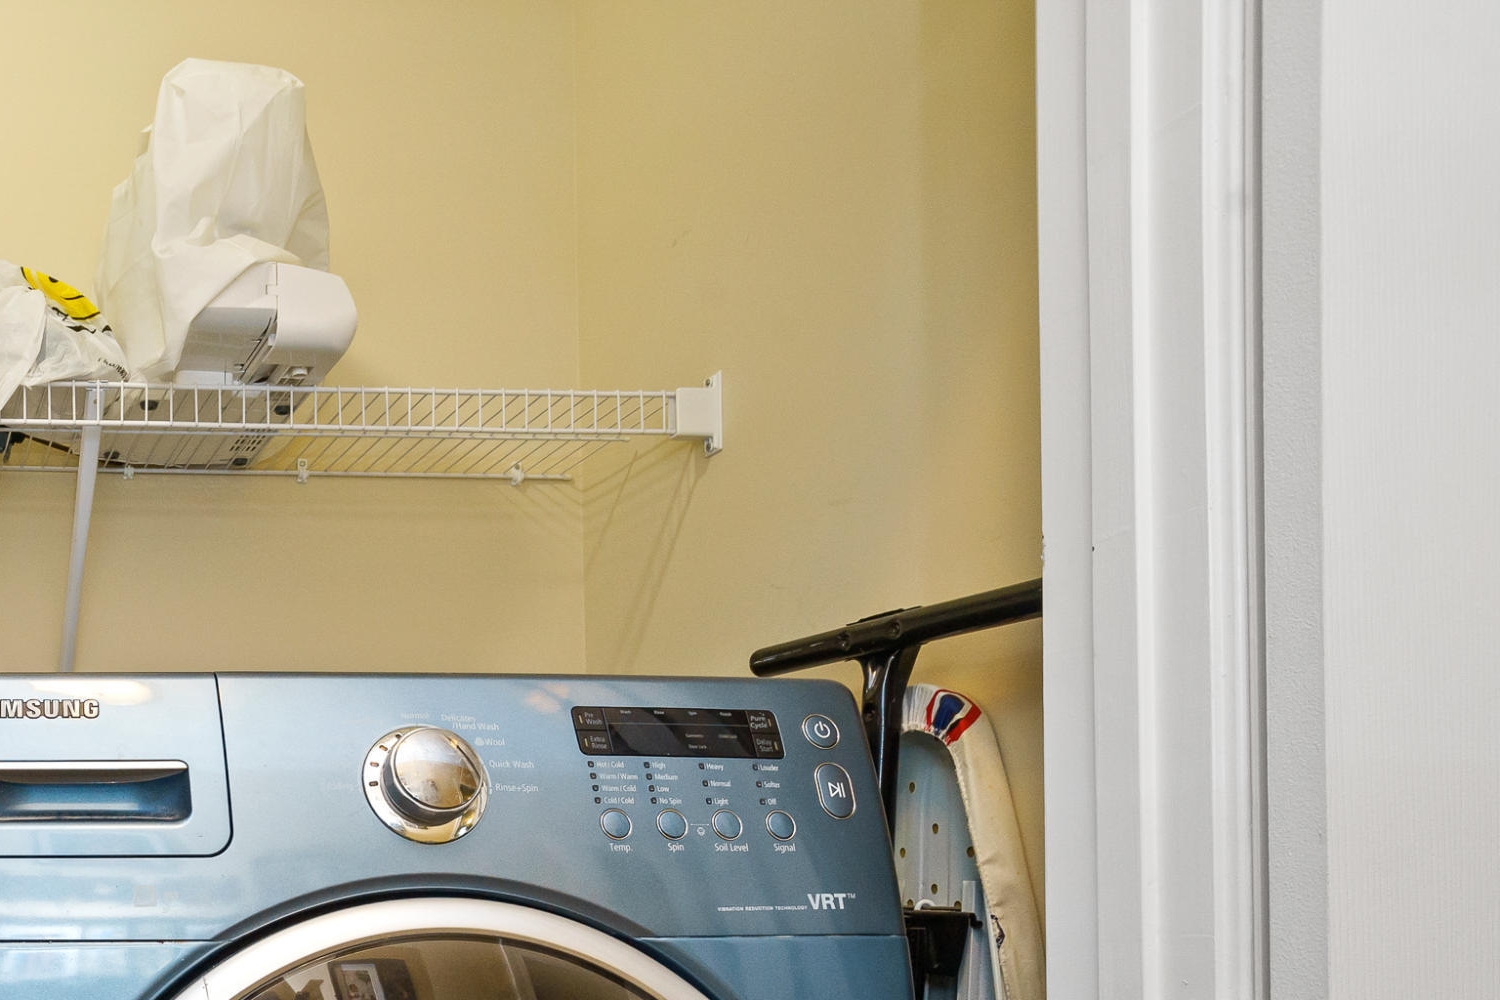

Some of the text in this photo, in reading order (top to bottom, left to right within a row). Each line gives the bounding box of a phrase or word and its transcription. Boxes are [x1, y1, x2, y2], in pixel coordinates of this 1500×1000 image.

[478, 723, 500, 731] Wash
[484, 738, 506, 746] Wool
[489, 760, 534, 769] Quick Wash
[706, 762, 724, 771] Heavy
[495, 784, 539, 792] Rinse+Spin
[610, 843, 632, 853] Temp.
[668, 843, 684, 852] Spin
[714, 843, 748, 852] Soil Level
[774, 843, 796, 854] Signal
